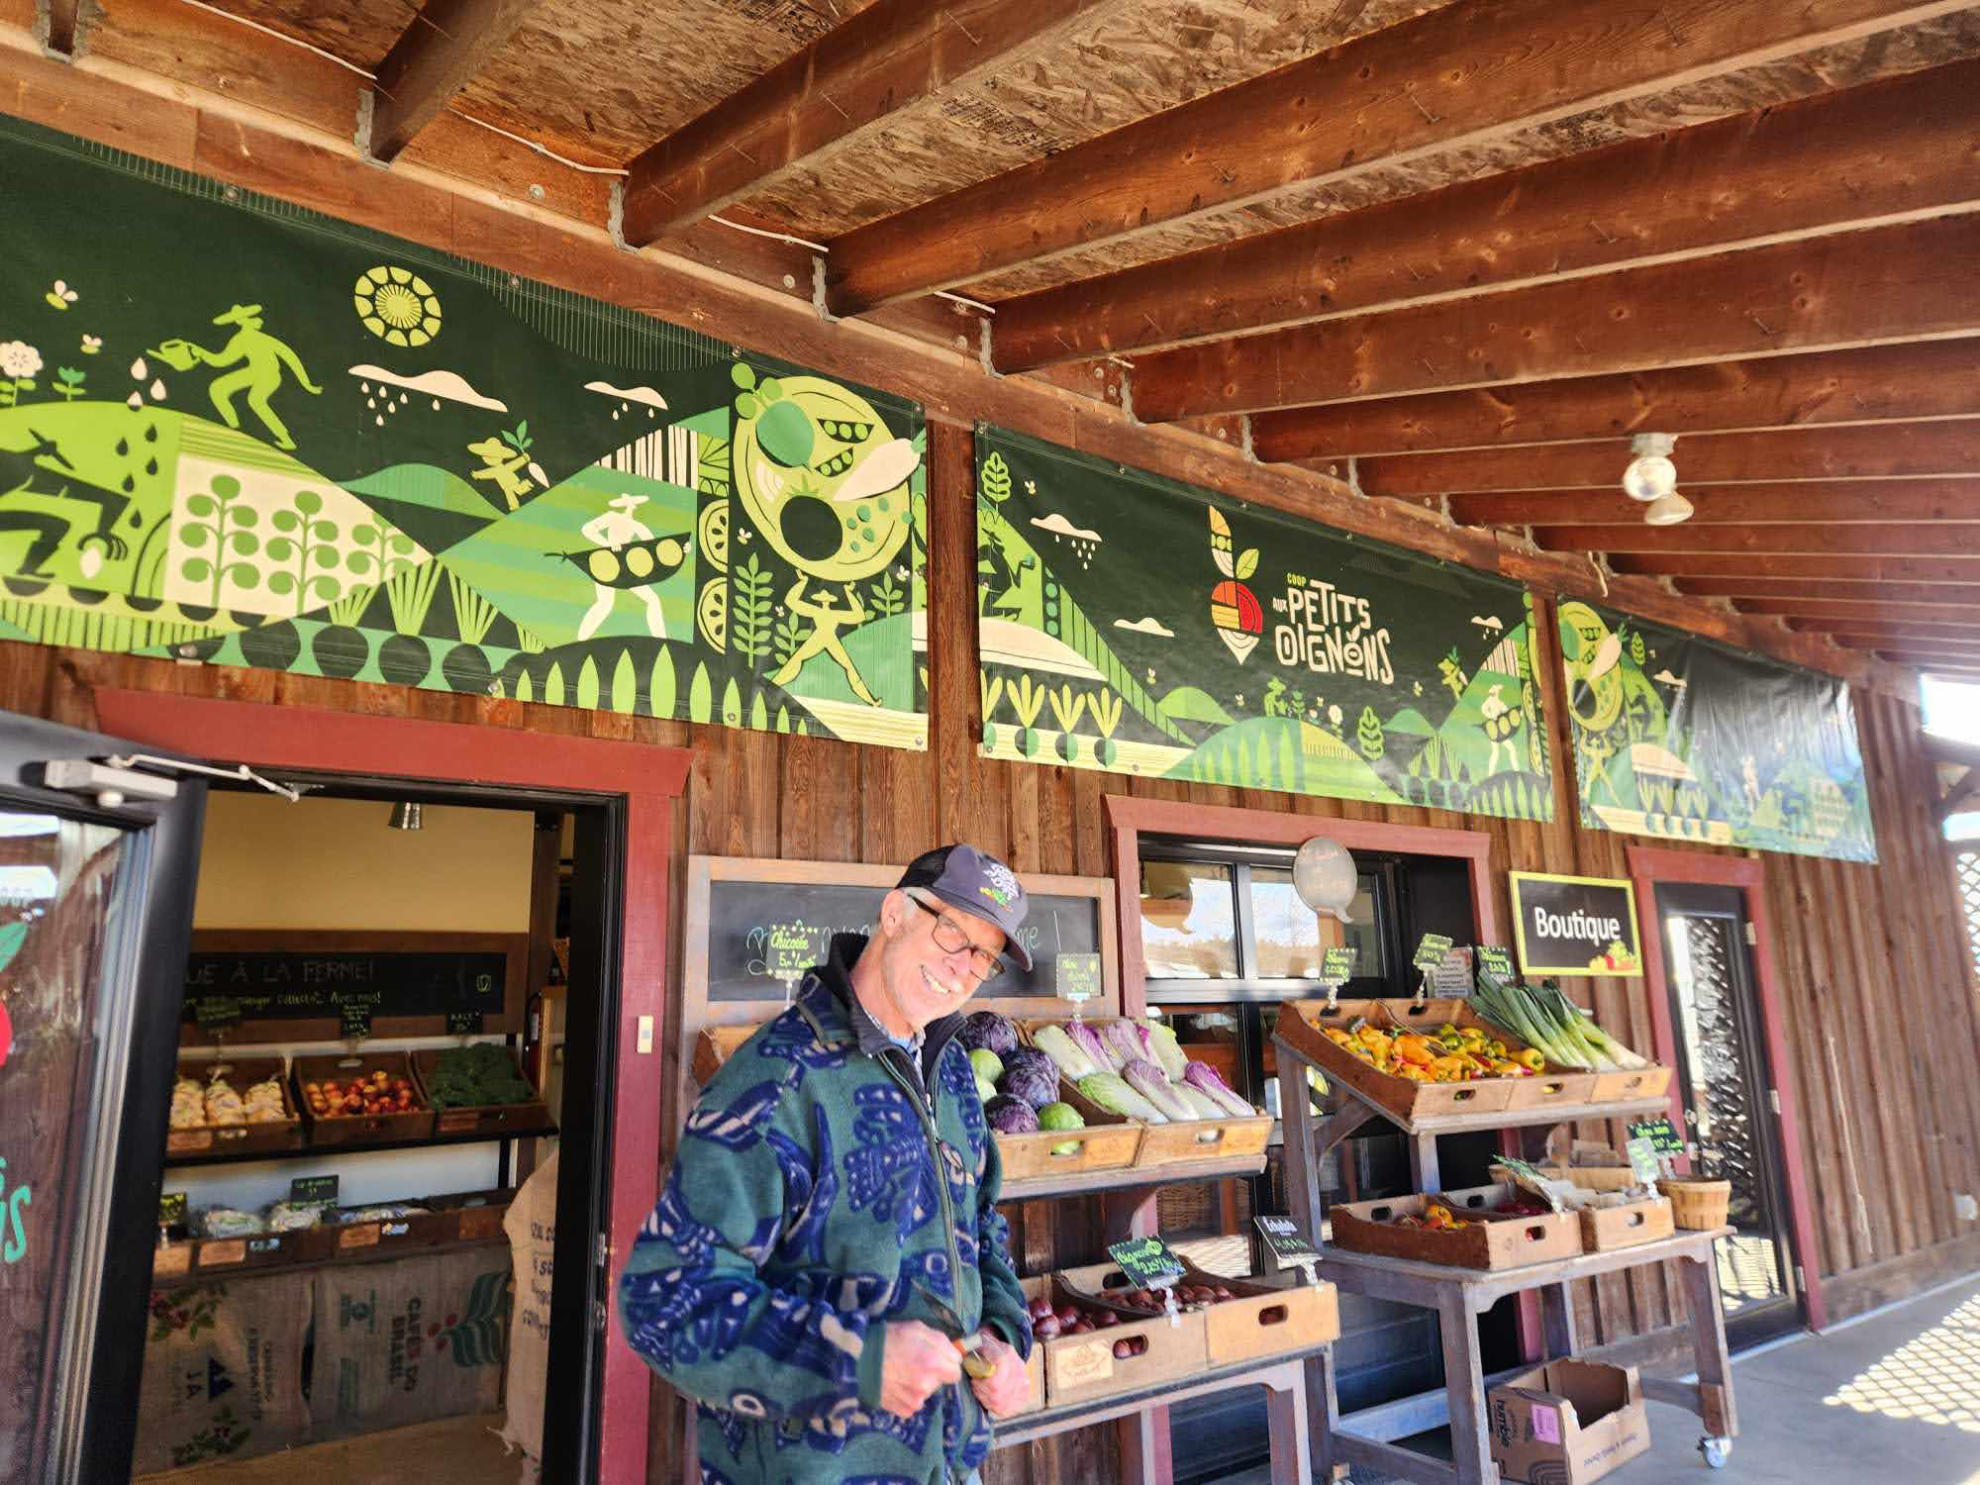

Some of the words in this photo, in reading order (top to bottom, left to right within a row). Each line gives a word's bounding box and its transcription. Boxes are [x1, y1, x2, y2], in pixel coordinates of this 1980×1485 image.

[1287, 572, 1307, 587] COOP
[1287, 579, 1372, 630] PETITS
[1275, 623, 1394, 685] OIGNONS
[1534, 906, 1621, 947] Boutique
